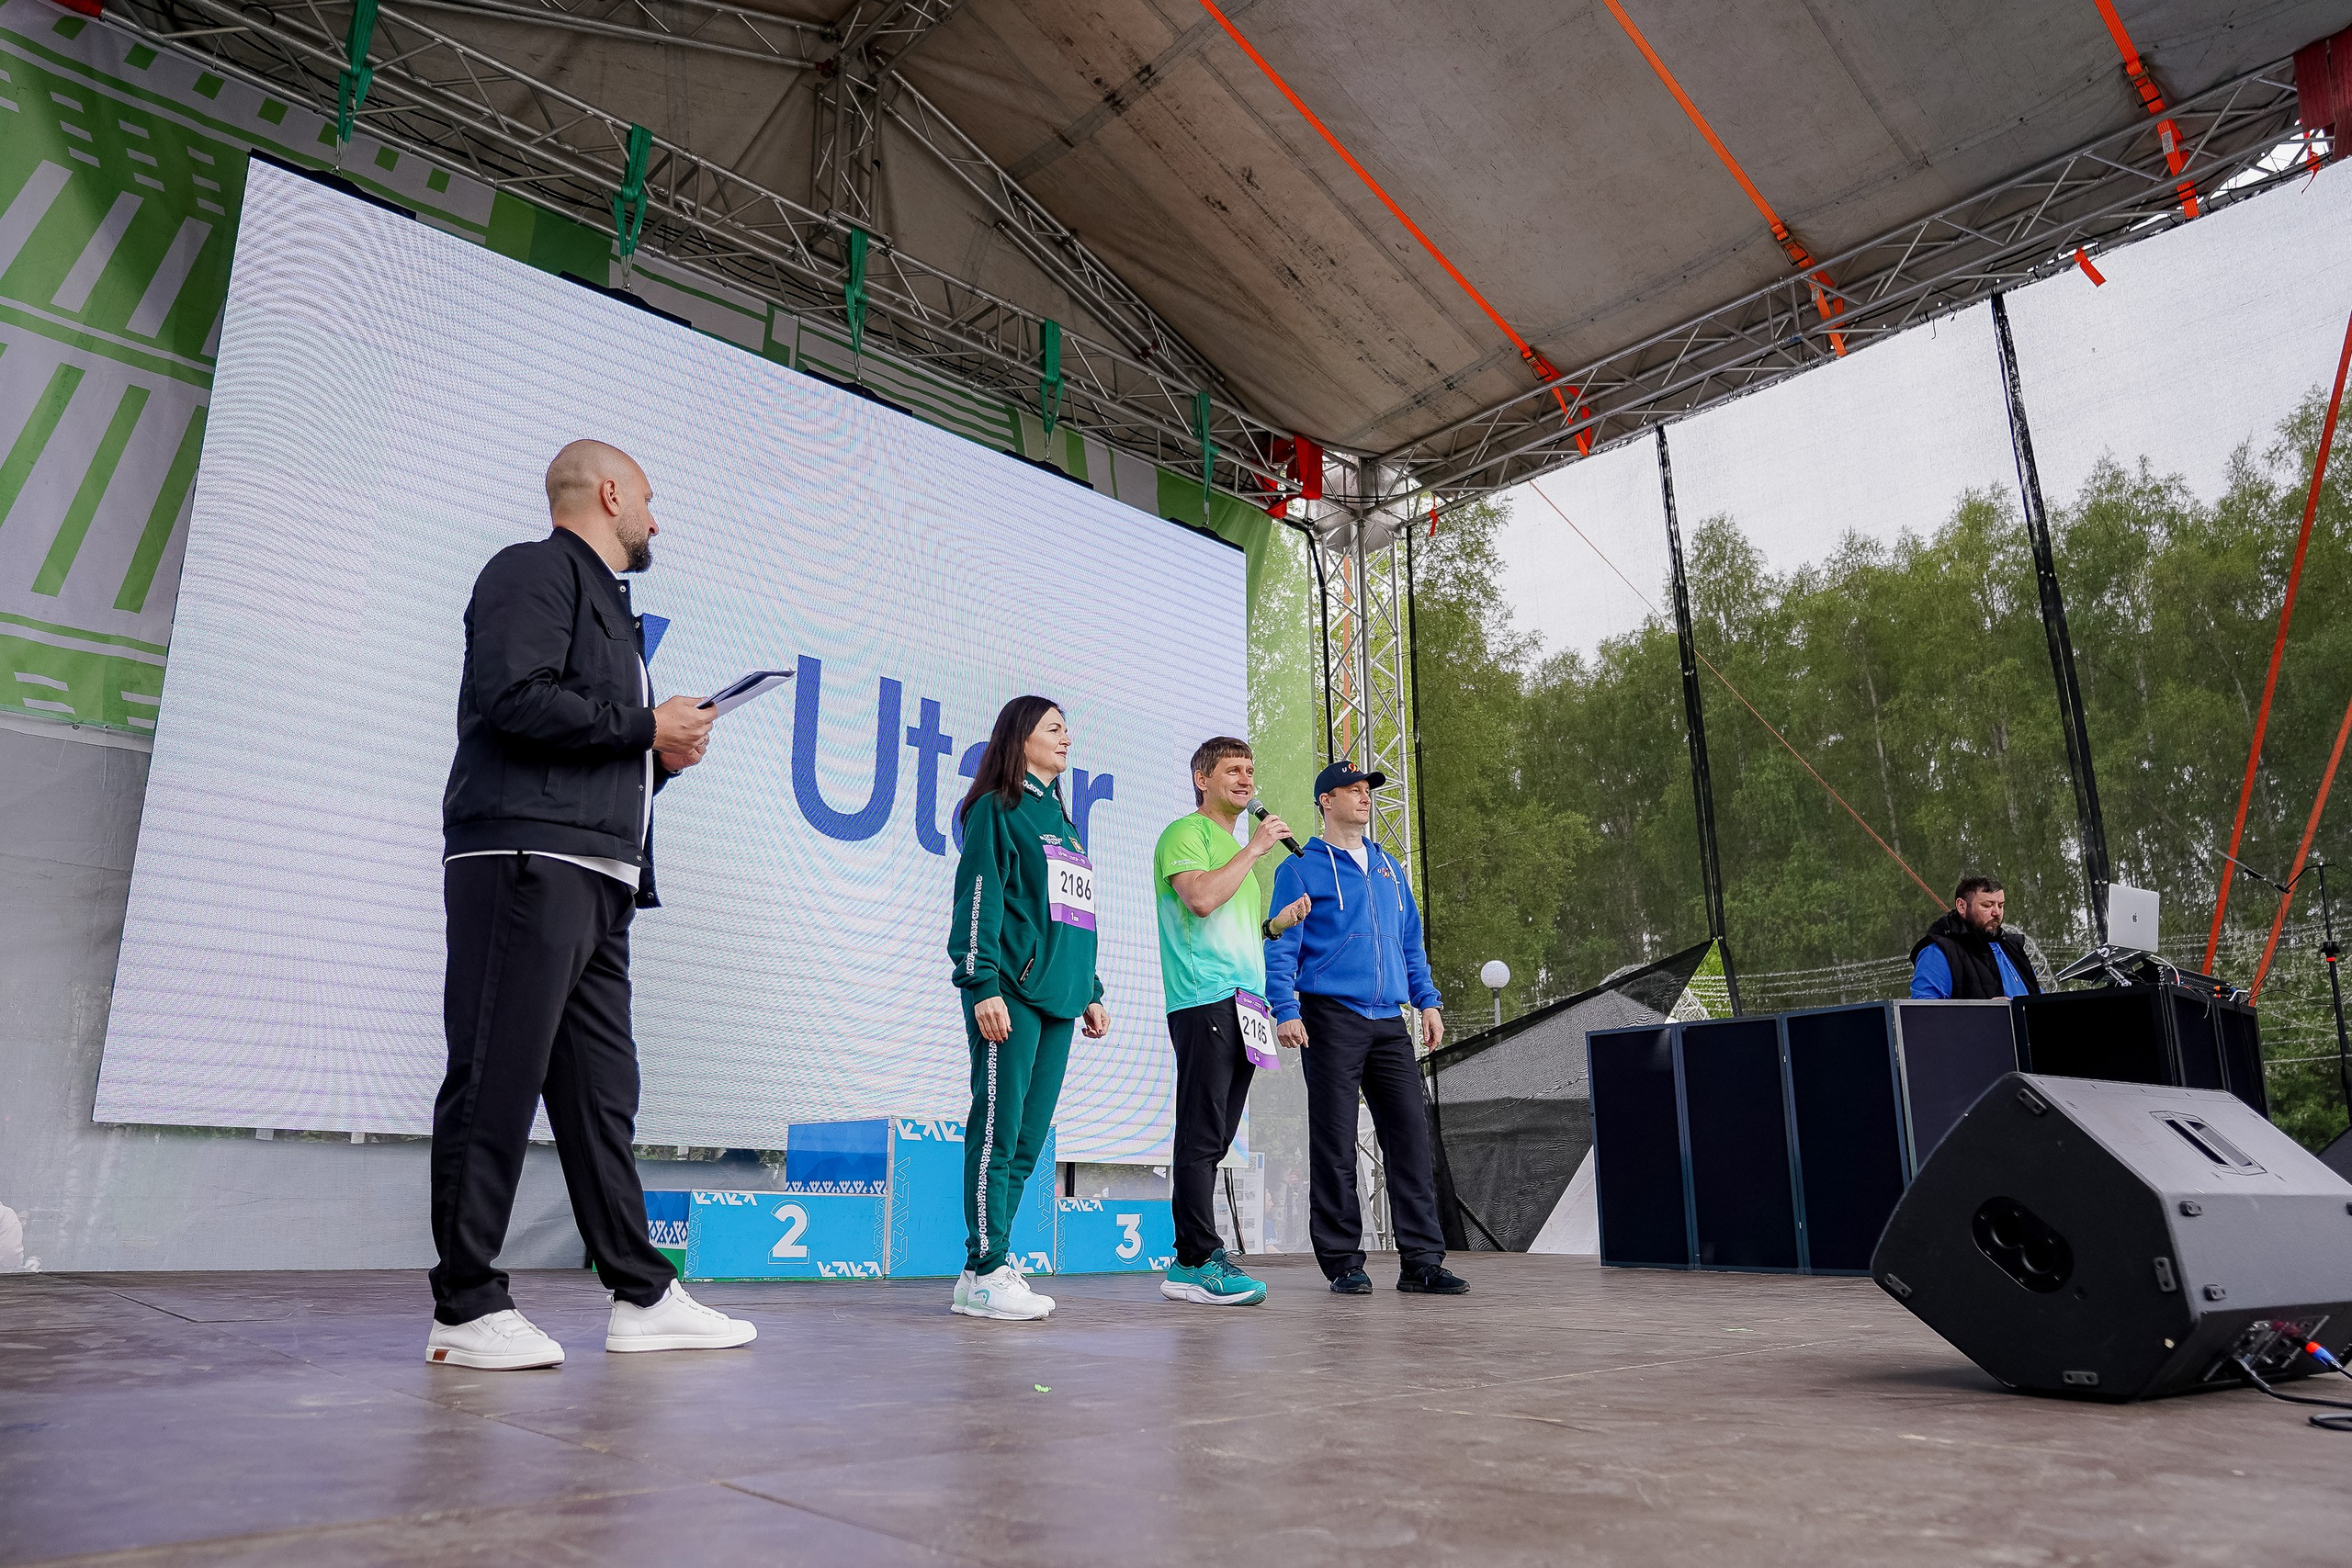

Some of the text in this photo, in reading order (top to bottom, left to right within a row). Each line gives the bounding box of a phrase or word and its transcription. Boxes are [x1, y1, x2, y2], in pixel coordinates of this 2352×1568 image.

[1060, 870, 1091, 901] 2186
[769, 1202, 808, 1259] 2
[1114, 1213, 1144, 1261] 3
